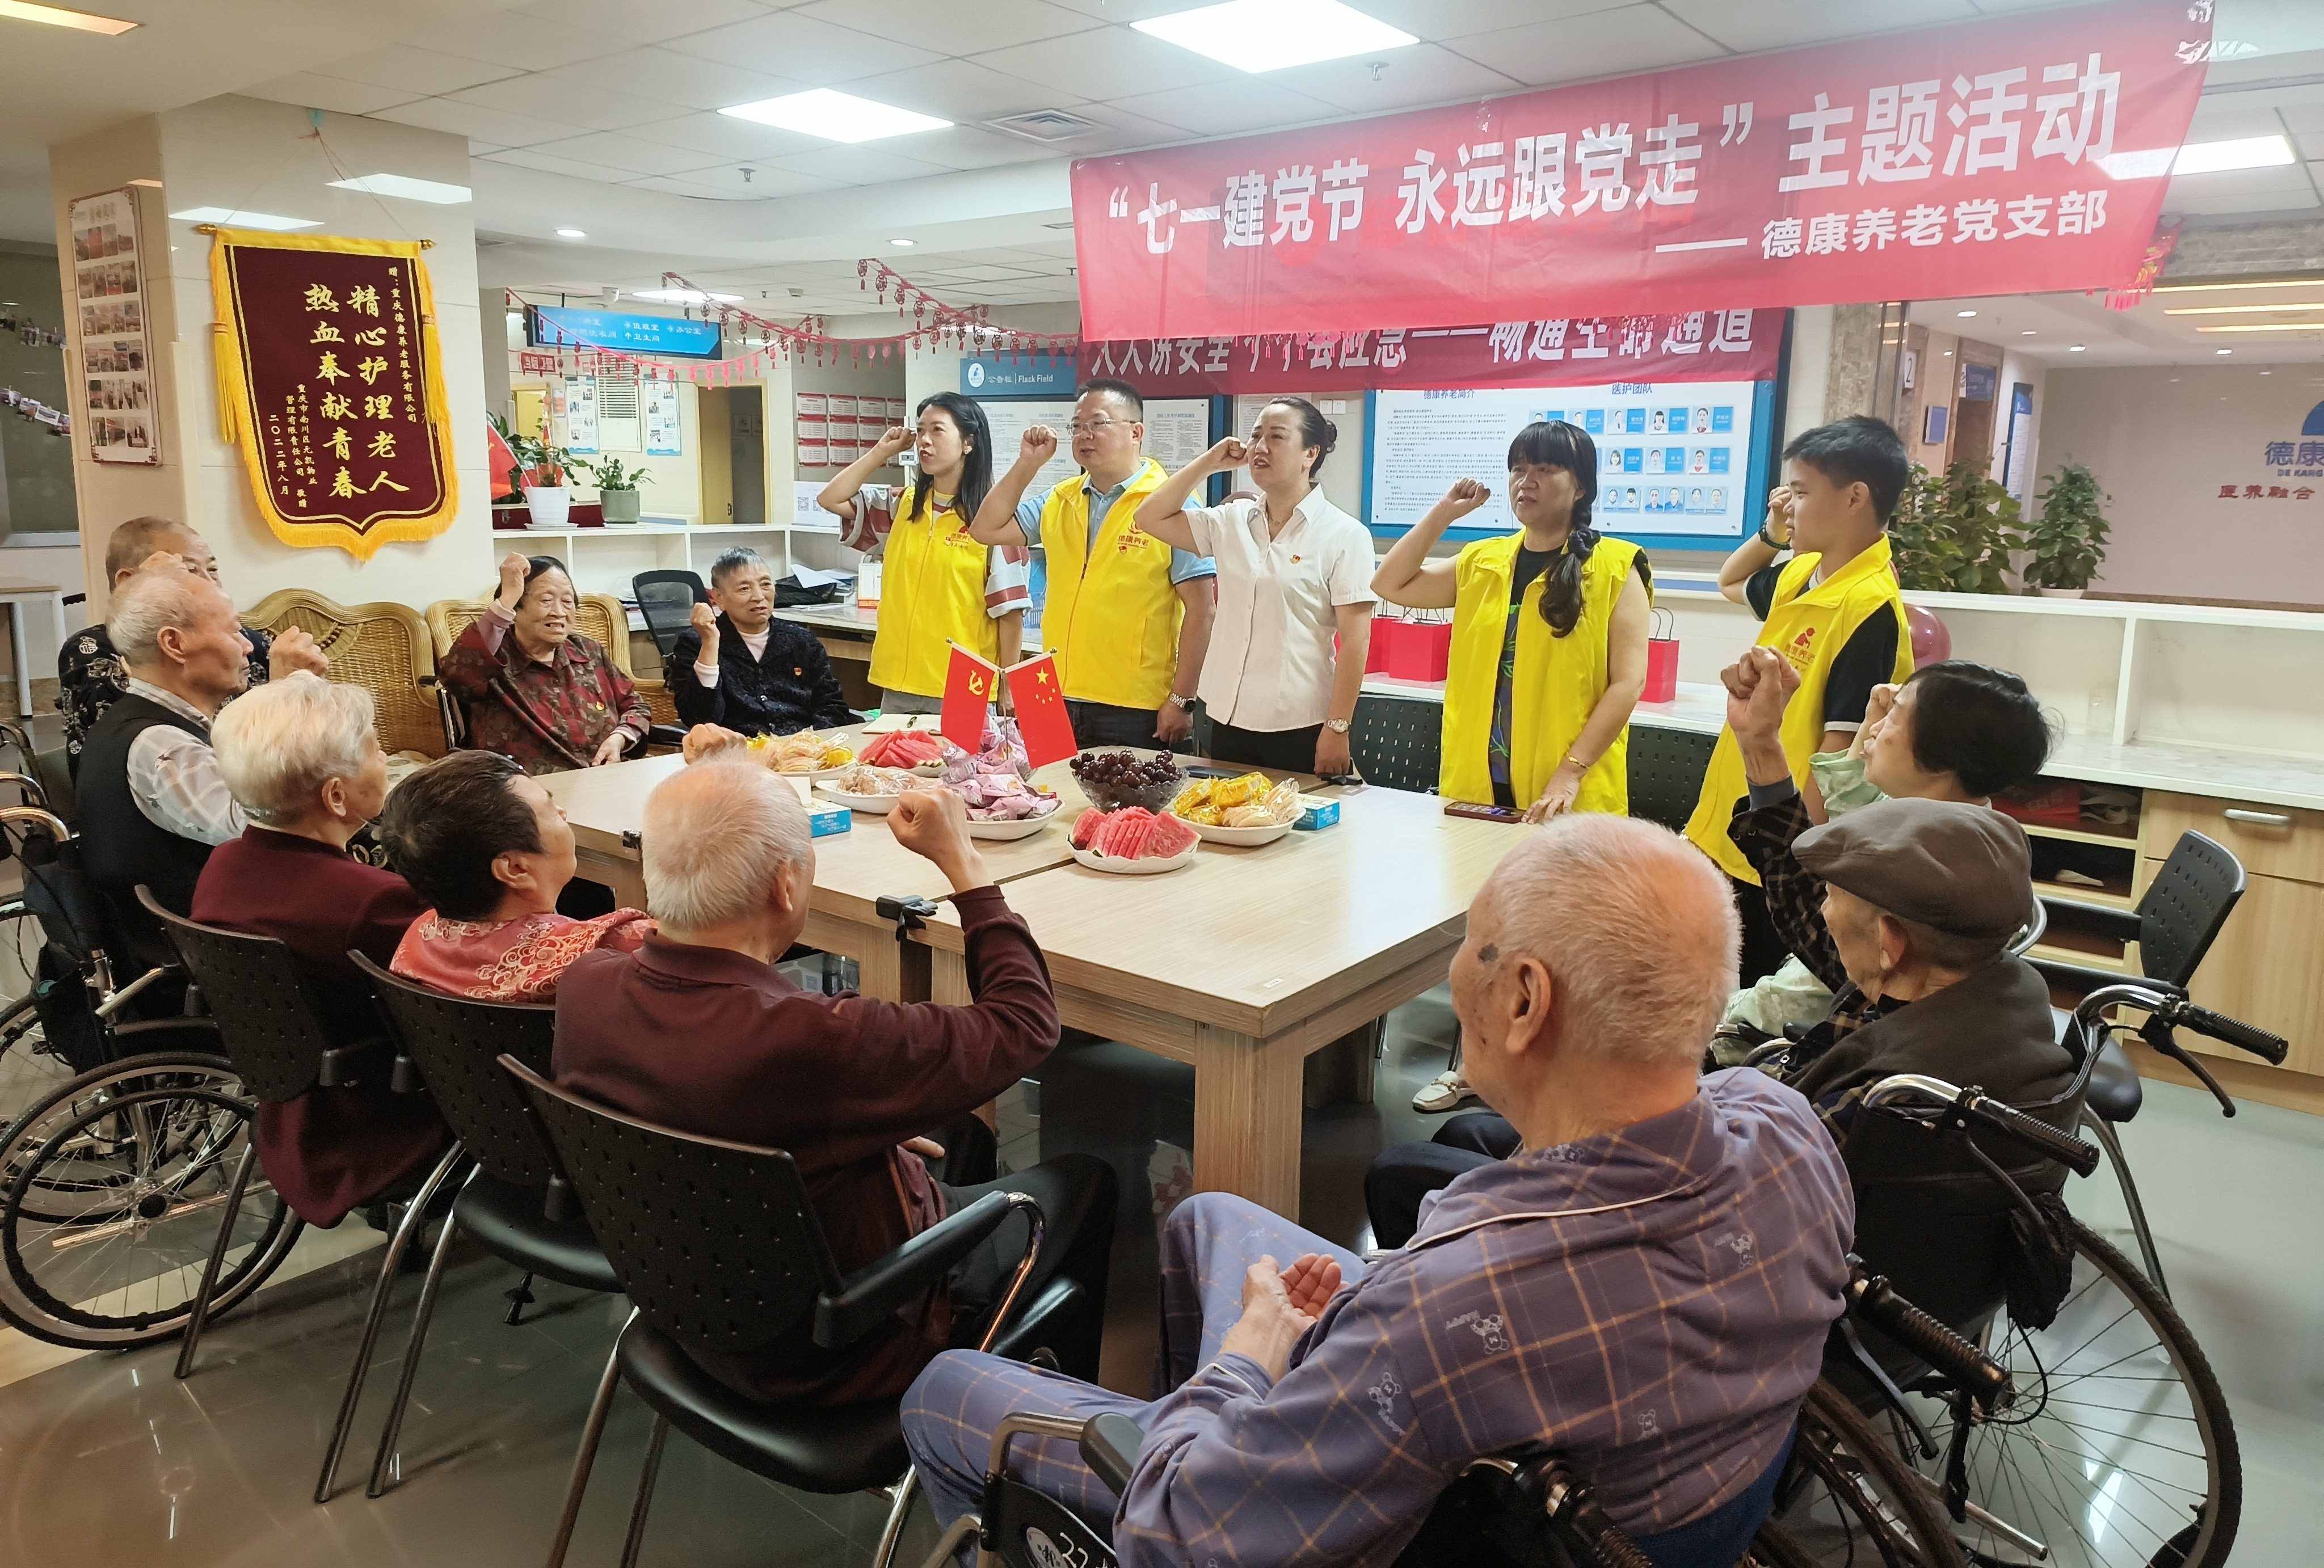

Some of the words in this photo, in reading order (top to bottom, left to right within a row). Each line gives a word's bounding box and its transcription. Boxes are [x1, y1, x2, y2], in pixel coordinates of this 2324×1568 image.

[1779, 52, 2121, 193] 主题活动
[633, 333, 660, 342] 卫生间
[676, 326, 701, 335] 办公室
[304, 283, 367, 500] 热血奉献青春
[346, 284, 410, 493] 精心护理老人
[1424, 389, 1475, 399] 德康养老简介
[1611, 382, 1653, 395] 医护团队
[2264, 441, 2324, 466] 德康
